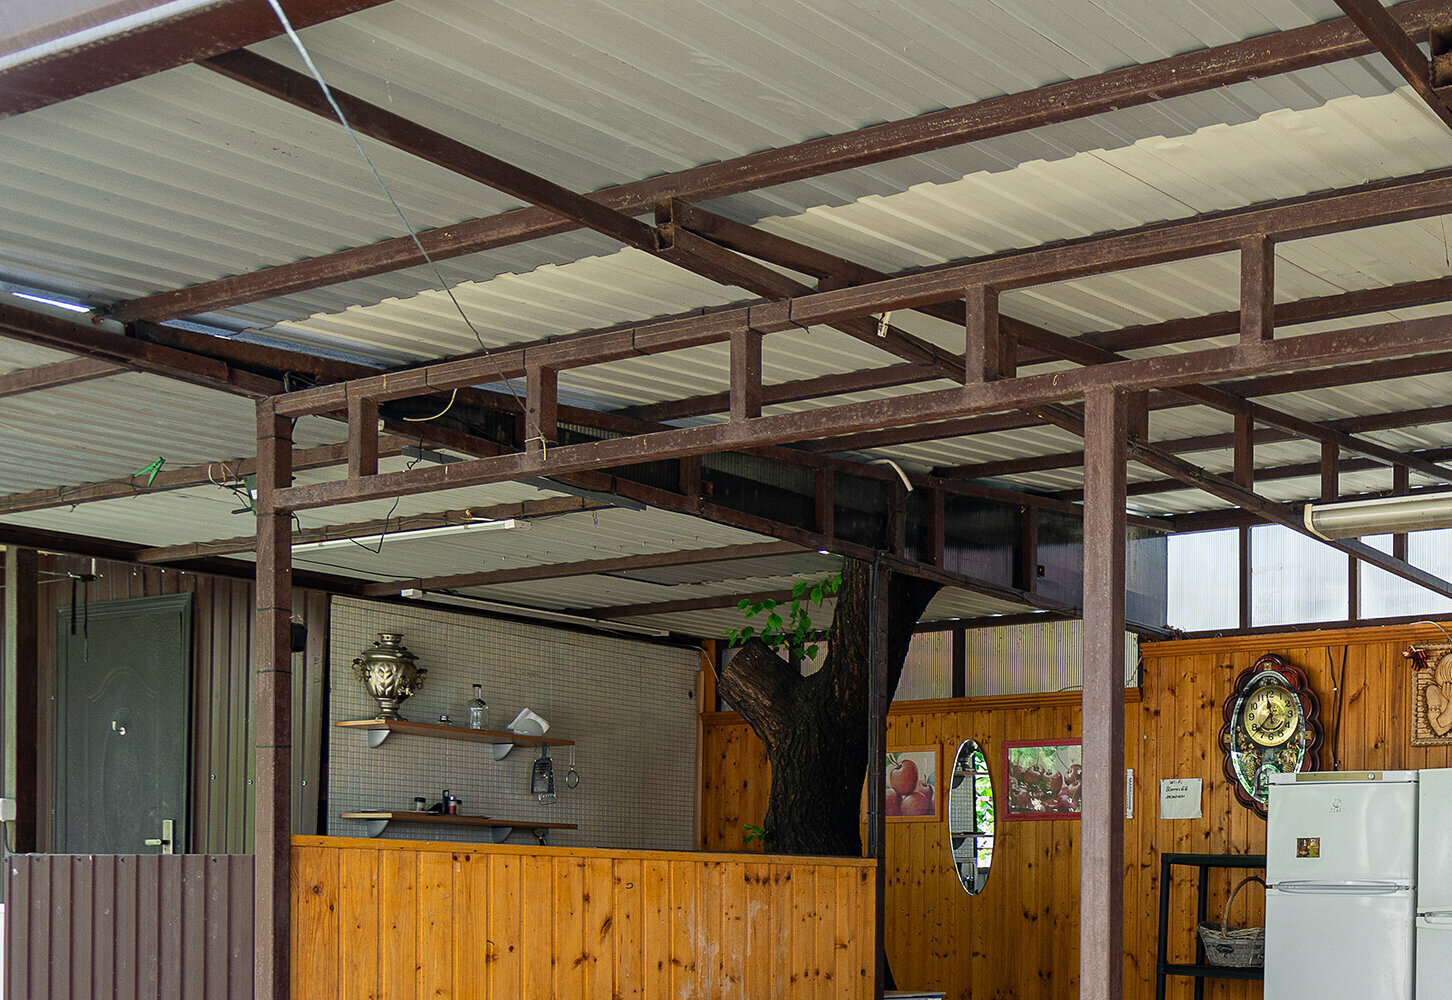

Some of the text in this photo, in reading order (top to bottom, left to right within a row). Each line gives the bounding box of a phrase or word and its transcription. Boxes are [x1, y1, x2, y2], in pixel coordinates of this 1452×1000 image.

[1257, 694, 1264, 702] 11
[1250, 702, 1258, 710] 10
[1248, 712, 1255, 721] 9
[1287, 710, 1293, 718] 3
[1251, 723, 1257, 731] 8
[1268, 732, 1274, 740] 6
